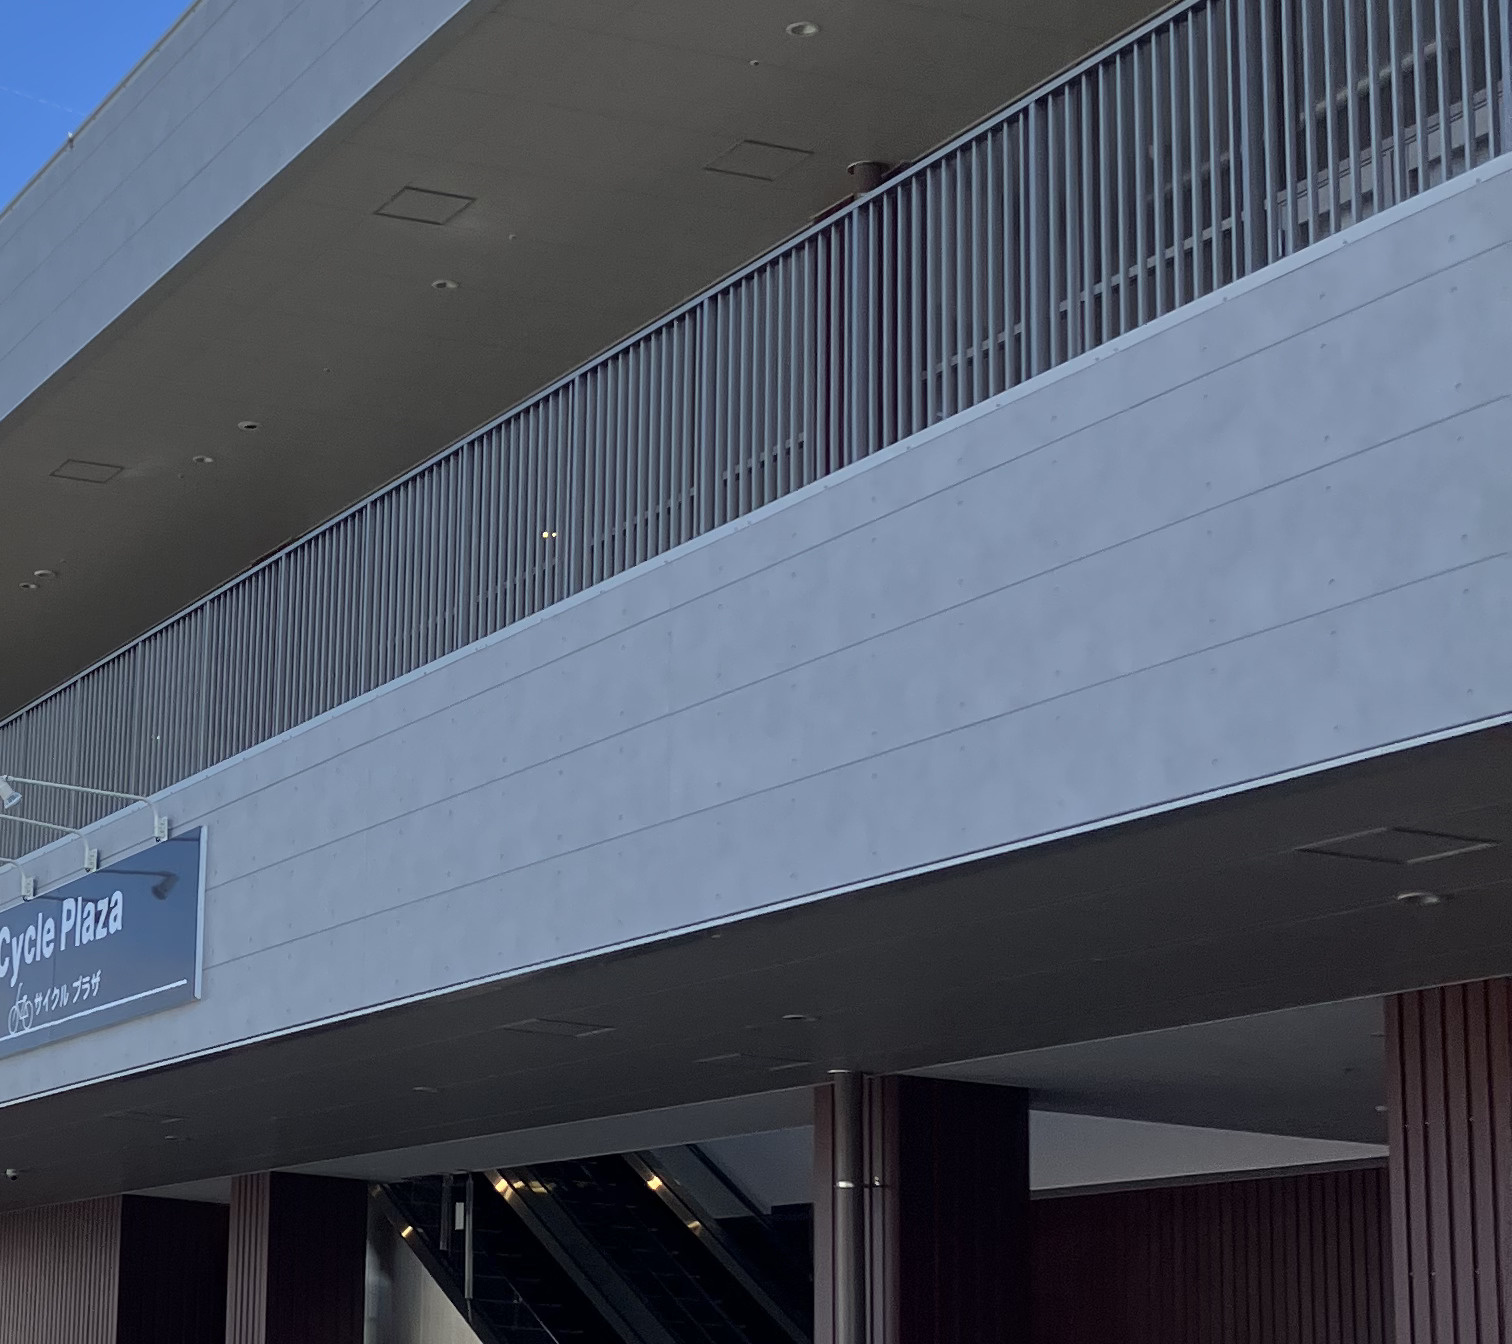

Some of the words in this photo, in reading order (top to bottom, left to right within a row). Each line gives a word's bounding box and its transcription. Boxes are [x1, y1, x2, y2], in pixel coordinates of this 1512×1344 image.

[60, 890, 123, 951] Plaza
[34, 983, 69, 1015] サイクル
[72, 969, 102, 1003] プラザ
